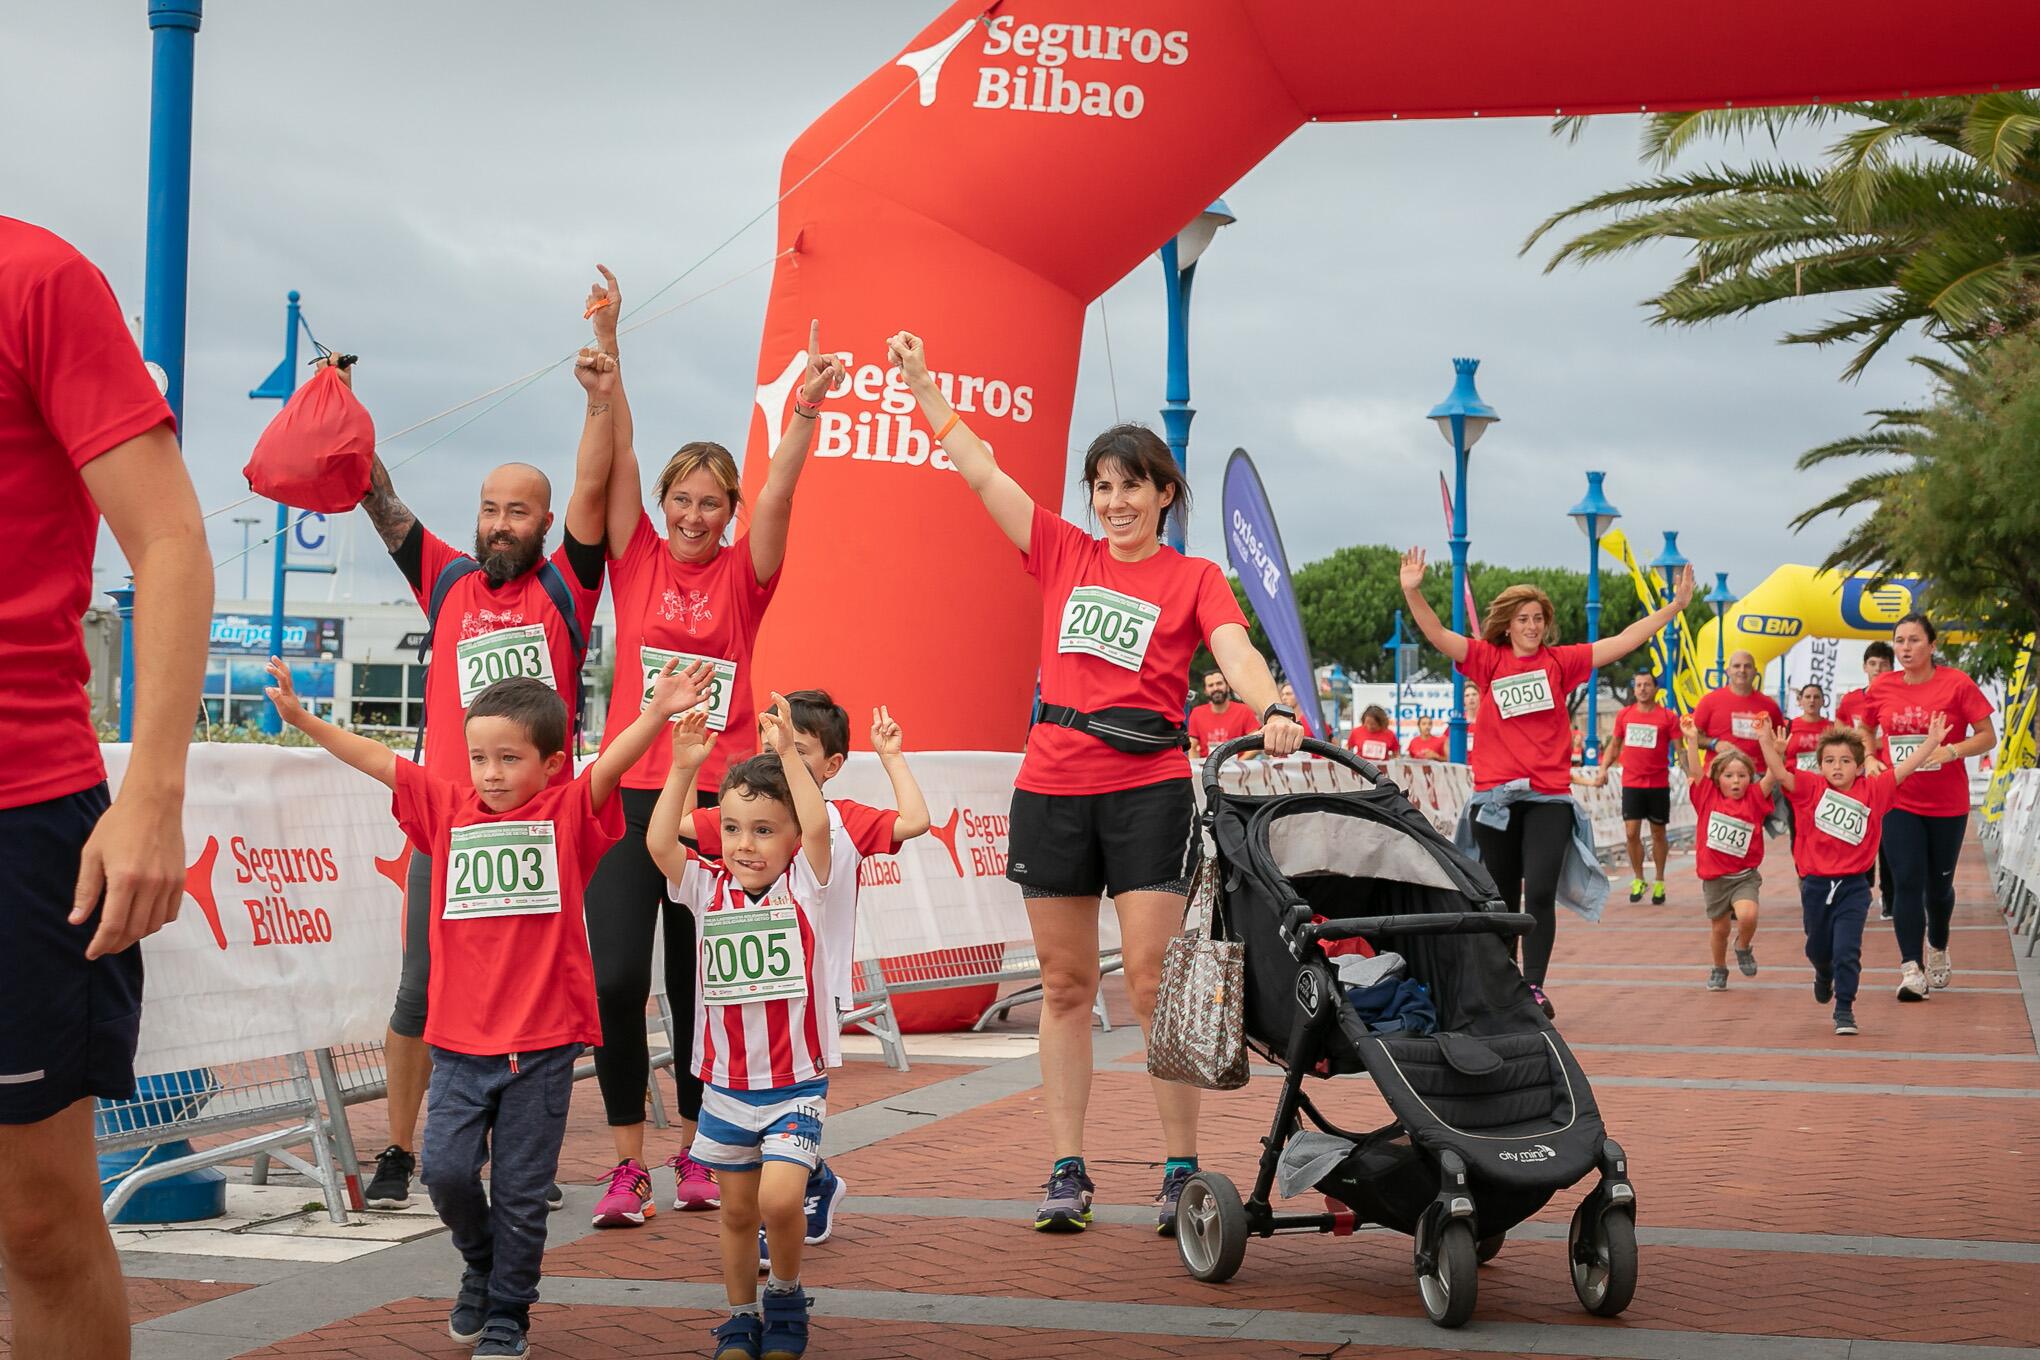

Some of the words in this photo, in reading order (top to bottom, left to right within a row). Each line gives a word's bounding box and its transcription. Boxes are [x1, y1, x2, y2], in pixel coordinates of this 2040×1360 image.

[983, 15, 1188, 65] Seguros
[973, 66, 1144, 119] Bilbao
[814, 410, 993, 471] Bilba
[295, 510, 326, 549] C
[1067, 604, 1143, 649] 2005
[1765, 618, 1799, 635] BM
[468, 645, 543, 690] 2003
[645, 668, 722, 711] 23
[1500, 683, 1544, 707] 2050
[1896, 745, 1914, 762] 20
[963, 809, 1008, 844] Segur
[1709, 822, 1747, 848] 2043
[1820, 803, 1863, 835] 2050
[231, 836, 338, 894] Seguros
[455, 847, 544, 895] 2003
[971, 846, 1008, 877] Bilb
[243, 896, 332, 946] Bilbao
[704, 932, 790, 982] 2005
[1499, 1150, 1518, 1161] city
[1519, 1149, 1545, 1159] mini
